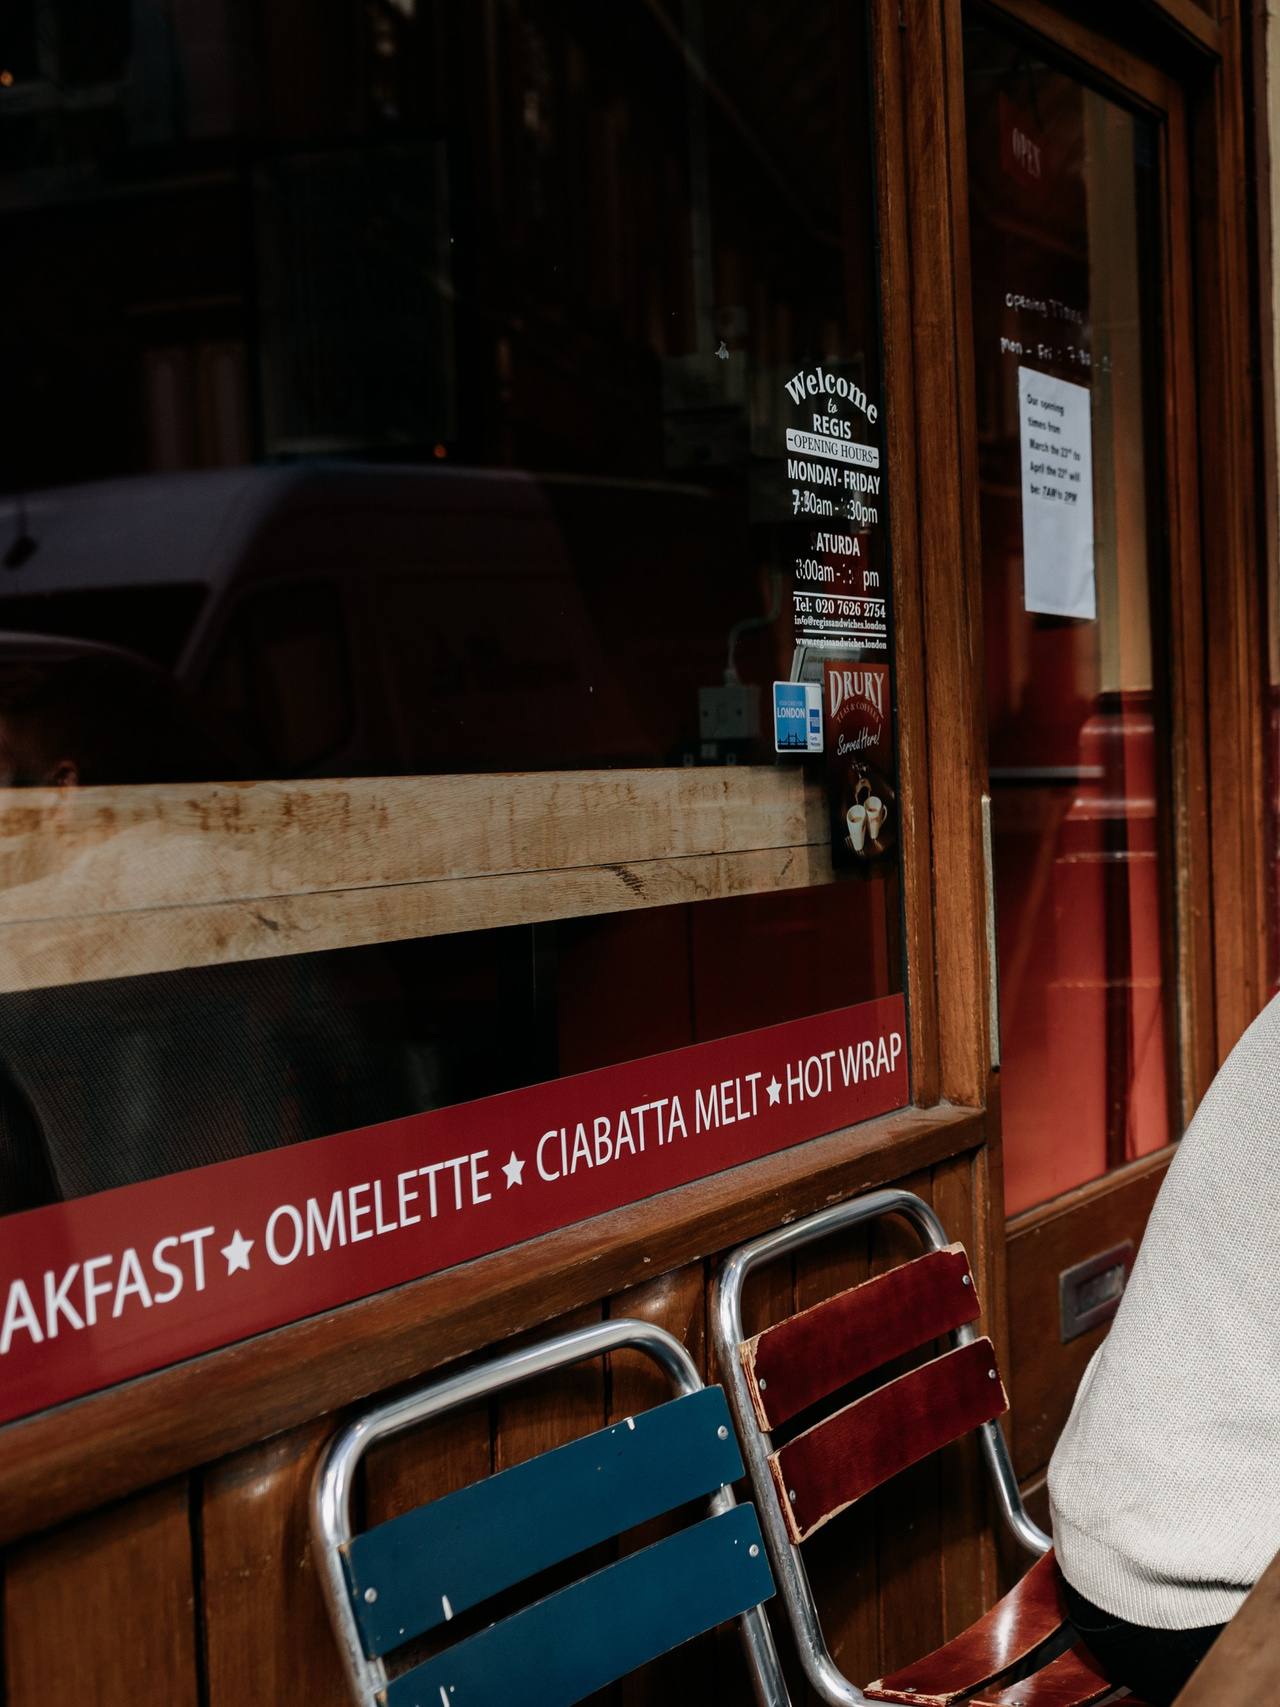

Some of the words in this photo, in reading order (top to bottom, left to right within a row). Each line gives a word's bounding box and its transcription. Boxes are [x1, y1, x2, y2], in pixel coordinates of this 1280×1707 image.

[784, 366, 878, 424] Welcome
[827, 398, 838, 414] to
[1027, 393, 1038, 405] Our
[813, 413, 852, 440] REGIS
[1029, 438, 1049, 452] March
[1030, 461, 1044, 475] April
[843, 470, 880, 496] FRIDAY
[841, 497, 878, 527] :30pm
[793, 596, 813, 613] Tel:
[815, 598, 835, 615] 020
[837, 600, 861, 617] 7626
[863, 602, 886, 619] 2754
[794, 614, 887, 631] info@regissandwiches.london
[795, 636, 887, 650] www.regissandwiches.london
[828, 670, 884, 719] DRURY
[777, 707, 805, 719] LONDON
[837, 704, 850, 723] TEAS
[850, 703, 856, 711] &
[856, 701, 880, 723] COFFEES
[837, 730, 860, 756] Served
[861, 723, 882, 749] Here!
[0, 1226, 215, 1354] AKFAST
[265, 1150, 492, 1267] OMELETTE
[536, 1096, 688, 1182] CIABATTA
[695, 1071, 762, 1134] MELT
[786, 1050, 836, 1105] HOT
[838, 1032, 902, 1087] WRAP
